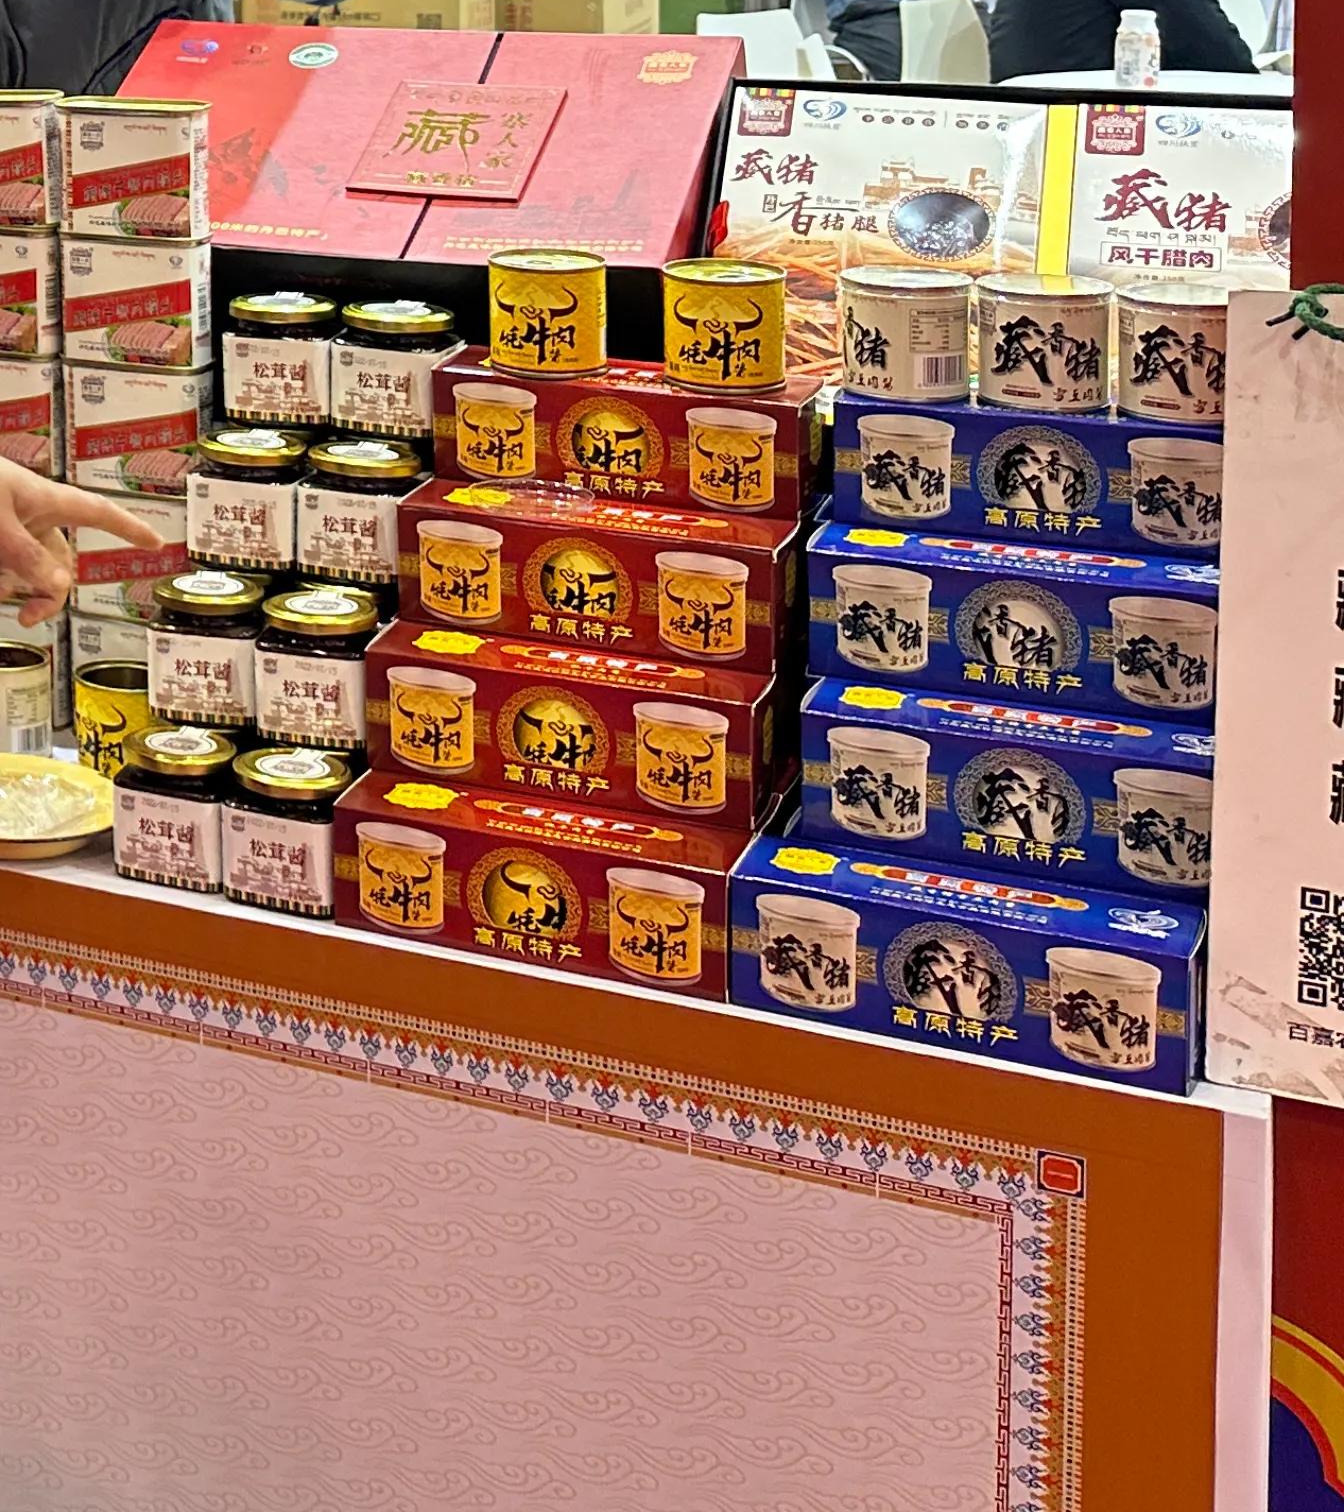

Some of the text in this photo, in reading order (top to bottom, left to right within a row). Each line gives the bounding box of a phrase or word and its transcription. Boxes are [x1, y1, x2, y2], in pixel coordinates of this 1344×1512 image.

[731, 148, 819, 186] 藏猪
[1094, 168, 1232, 233] 藏猪
[1108, 246, 1214, 269] 风干腊肉
[564, 472, 664, 499] 高原特产
[984, 506, 1103, 536] 高原特产
[529, 613, 634, 644] 高原特产
[962, 663, 1084, 695] 高原特产
[502, 763, 610, 796] 高原特产
[961, 830, 1086, 867] 高原特产
[473, 926, 583, 963] 高原特产
[891, 1005, 1020, 1047] 高原特产
